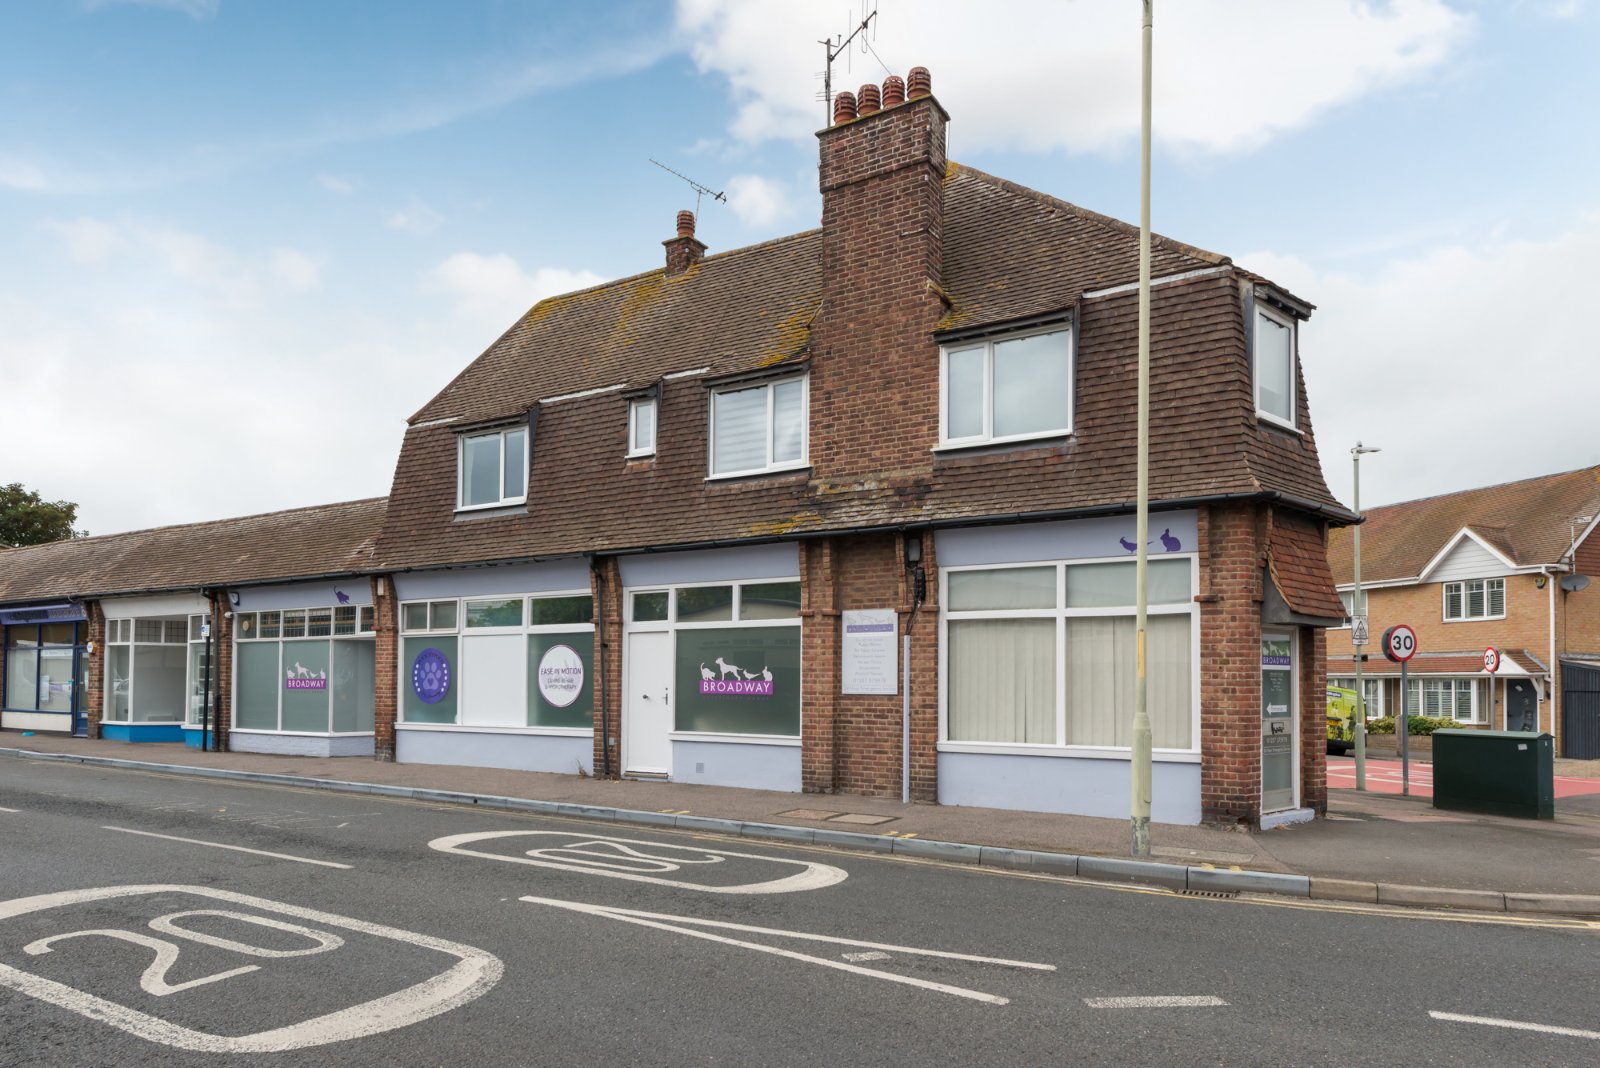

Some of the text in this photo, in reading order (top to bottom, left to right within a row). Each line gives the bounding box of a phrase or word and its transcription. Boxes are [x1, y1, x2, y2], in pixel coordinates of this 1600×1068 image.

[1393, 635, 1413, 650] 30
[1485, 654, 1495, 665] 20
[703, 682, 770, 692] BROADWAY
[23, 909, 346, 996] 20
